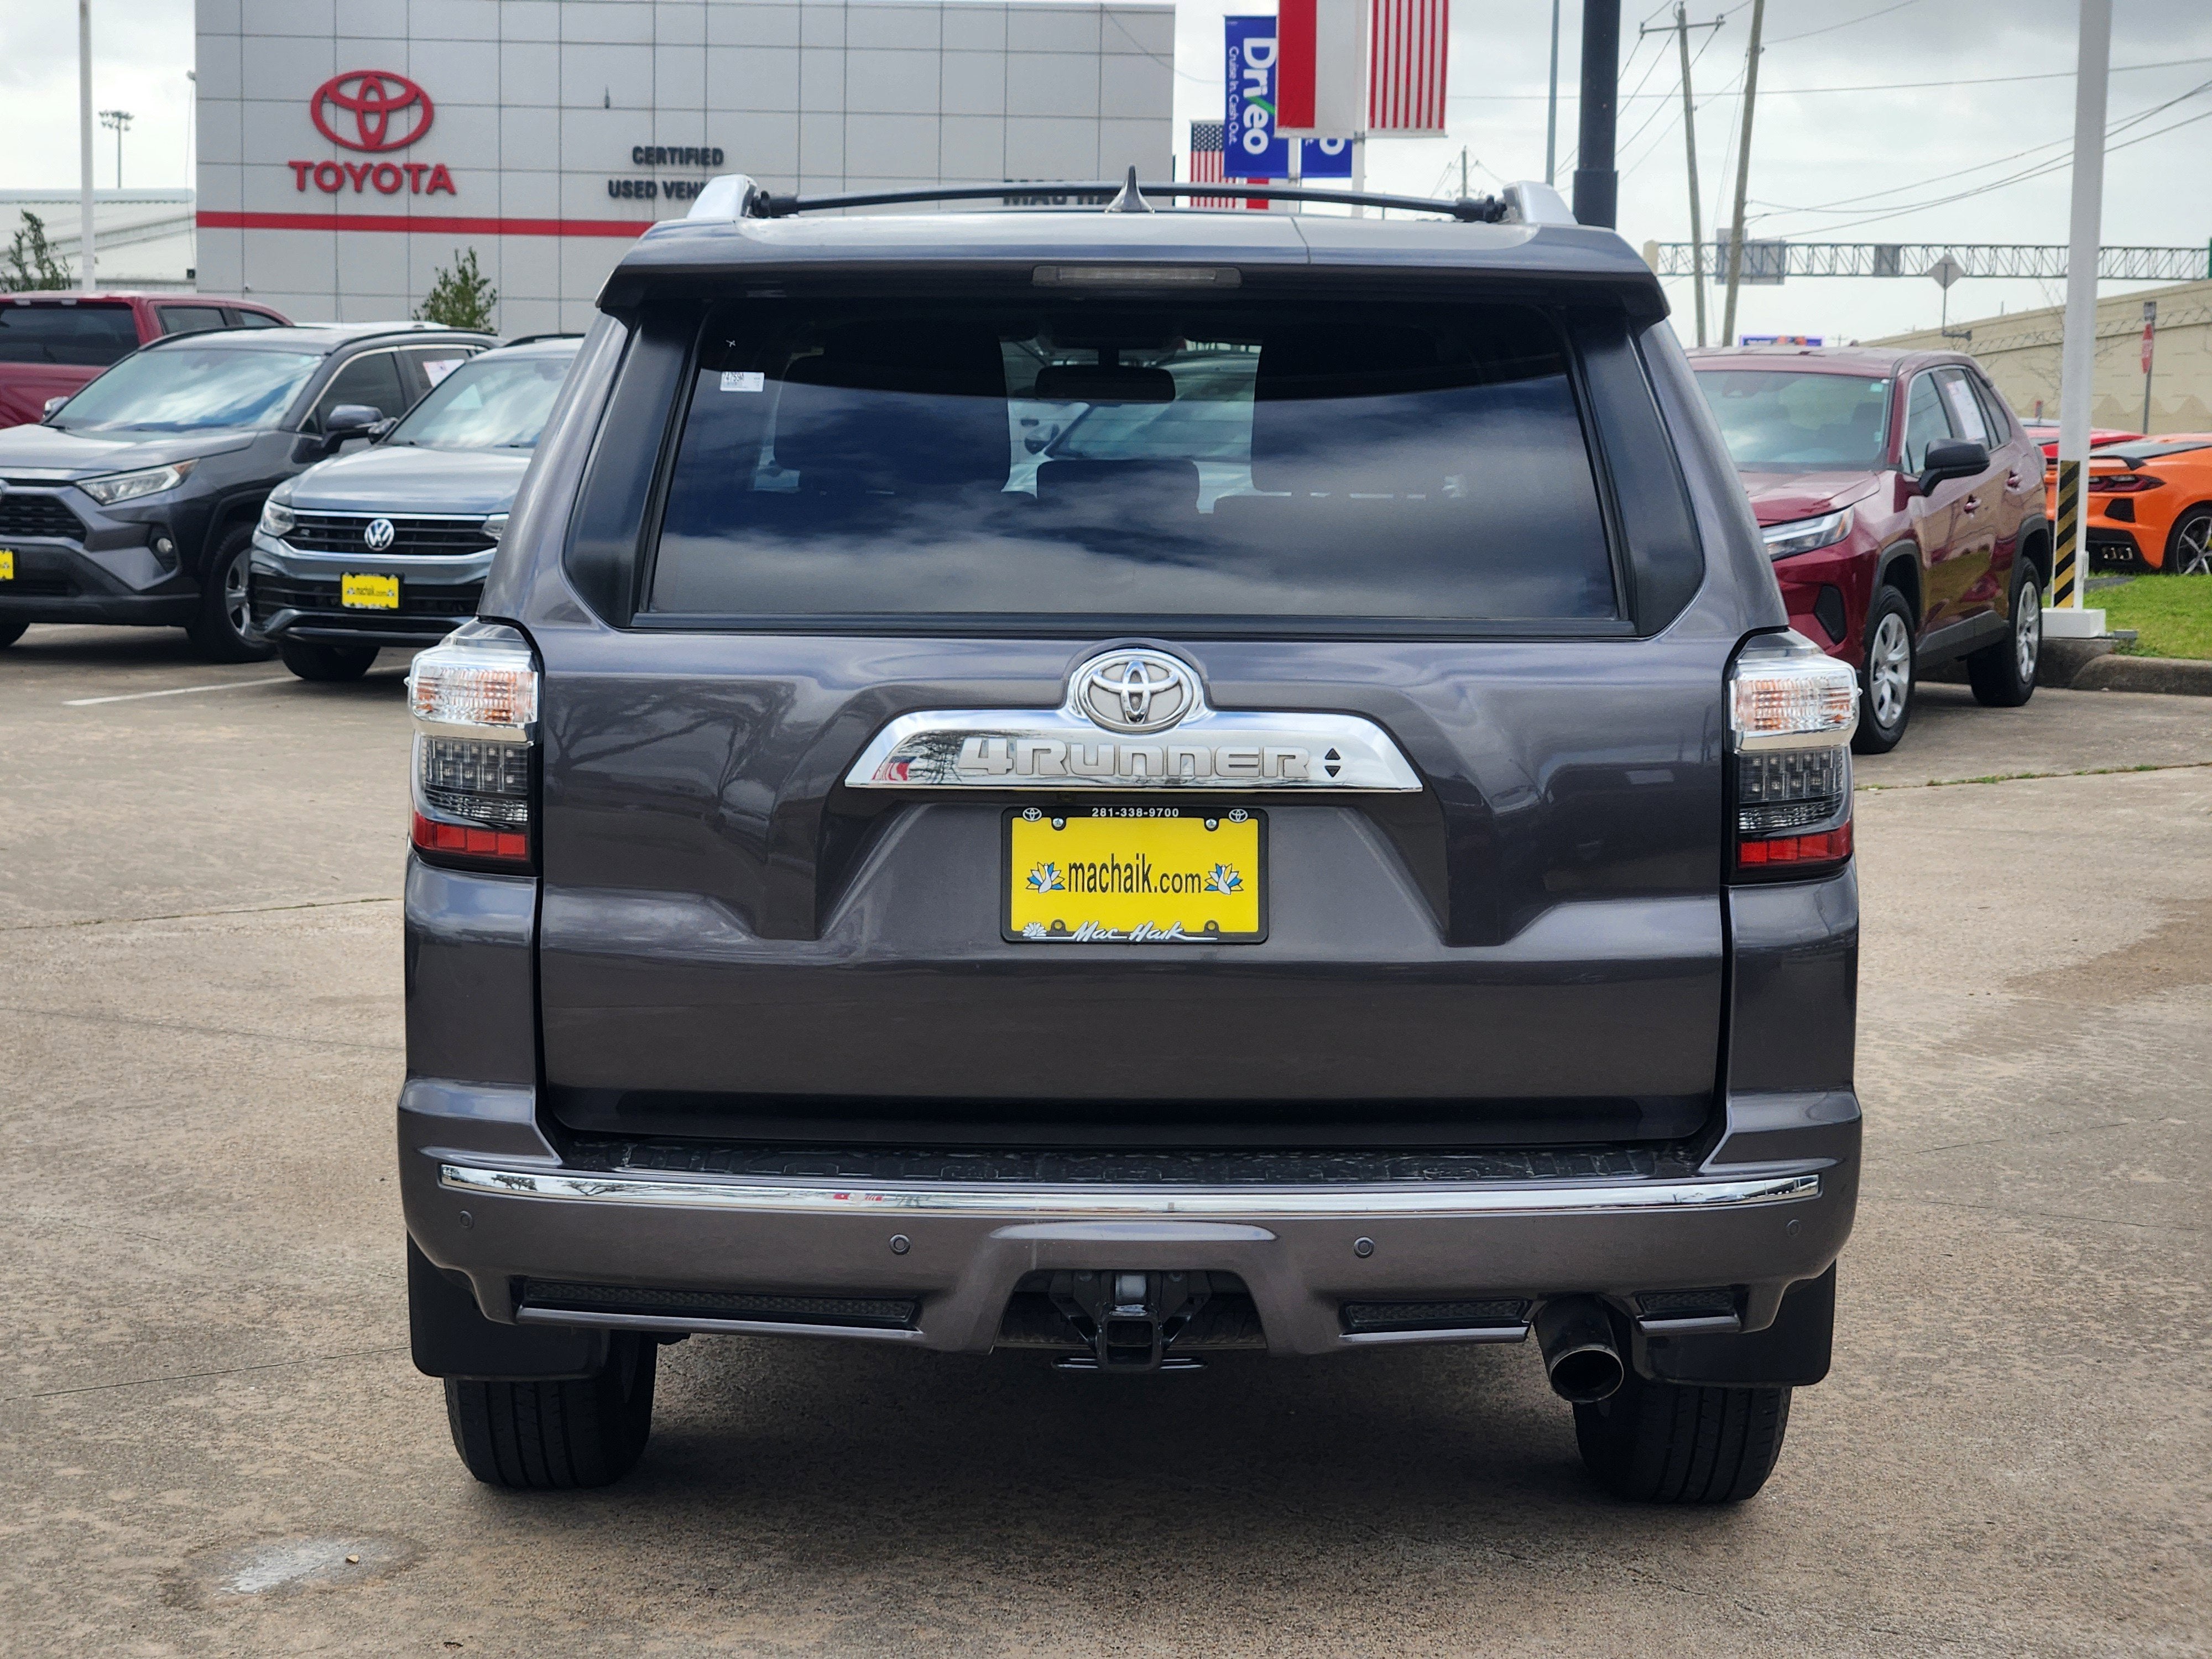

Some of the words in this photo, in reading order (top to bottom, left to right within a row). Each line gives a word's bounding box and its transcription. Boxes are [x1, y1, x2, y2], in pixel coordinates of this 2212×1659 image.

[632, 145, 724, 166] CERTIFIED
[288, 160, 456, 196] TOYOTA
[608, 179, 658, 199] USED
[1092, 807, 1180, 818] 281-338-9700
[1067, 853, 1202, 894] machaik.com
[1072, 921, 1127, 942] Mac
[1128, 921, 1190, 942] Haik
